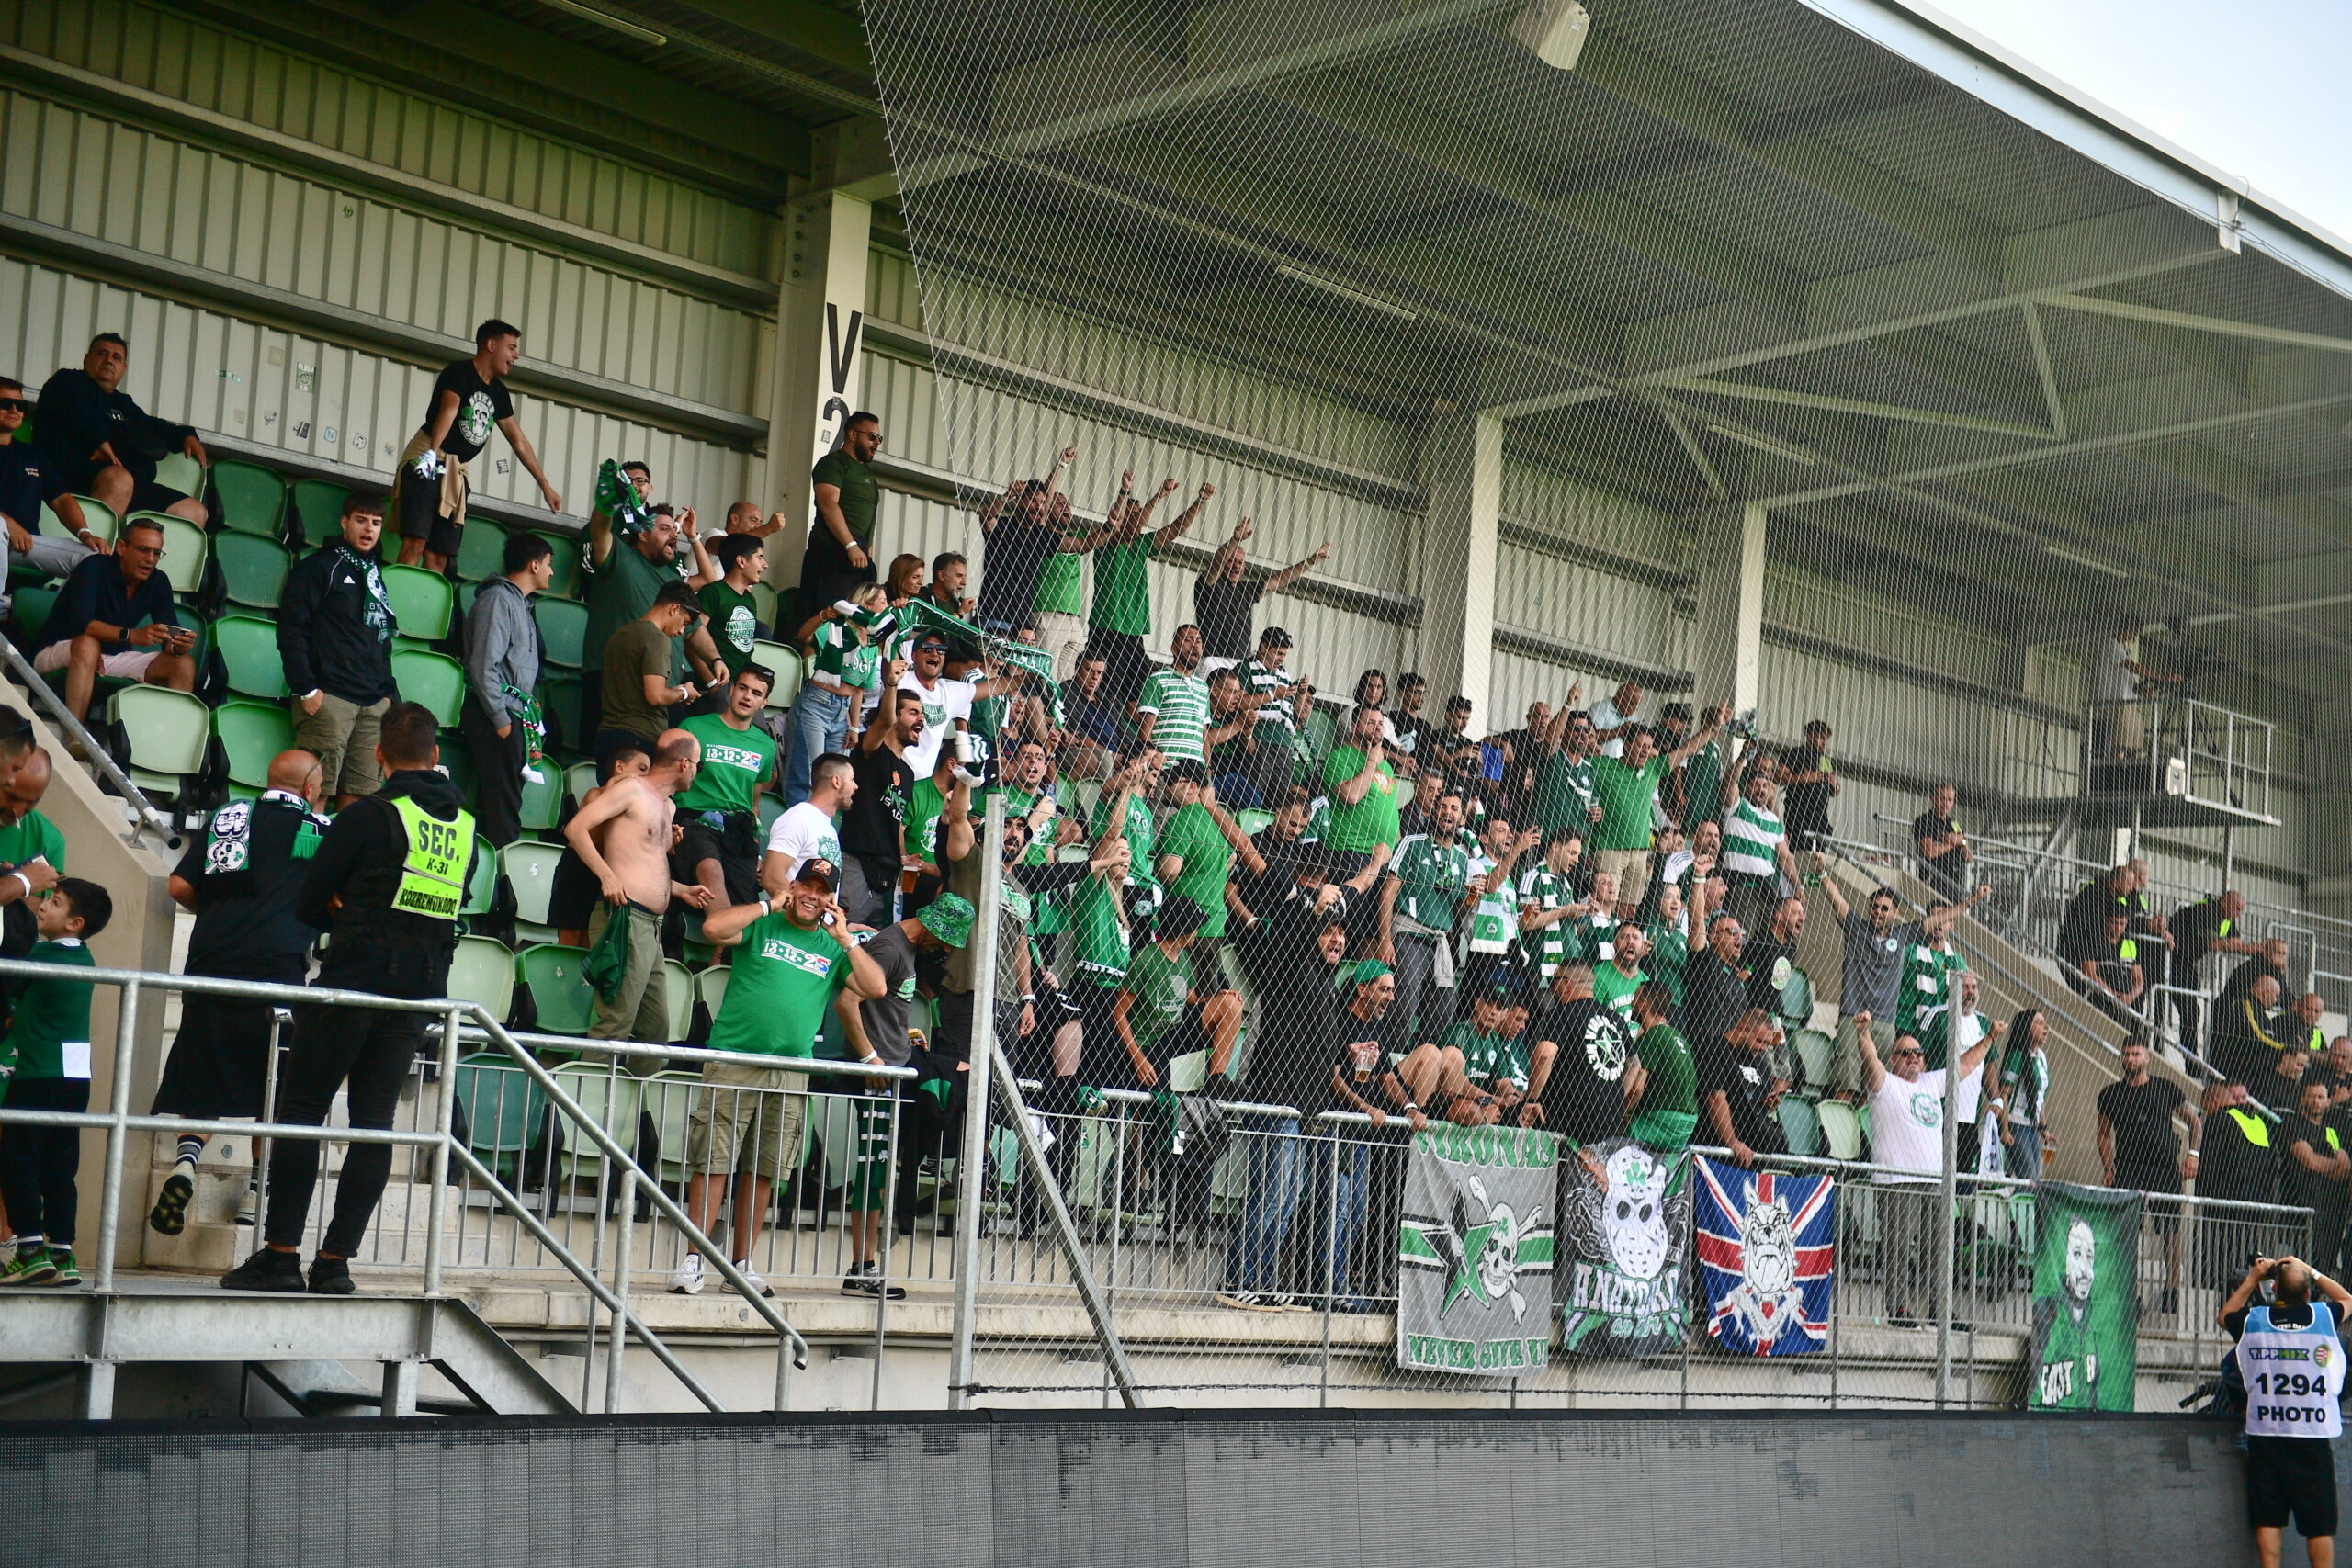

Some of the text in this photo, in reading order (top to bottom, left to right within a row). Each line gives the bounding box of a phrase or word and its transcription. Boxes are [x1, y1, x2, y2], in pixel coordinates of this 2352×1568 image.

[418, 819, 459, 863] SEC.
[426, 857, 448, 875] K-31
[1408, 1333, 1476, 1371] NEVER
[1479, 1337, 1523, 1370] GIVE
[2256, 1373, 2327, 1396] 1294
[2257, 1406, 2326, 1423] PHOTO
